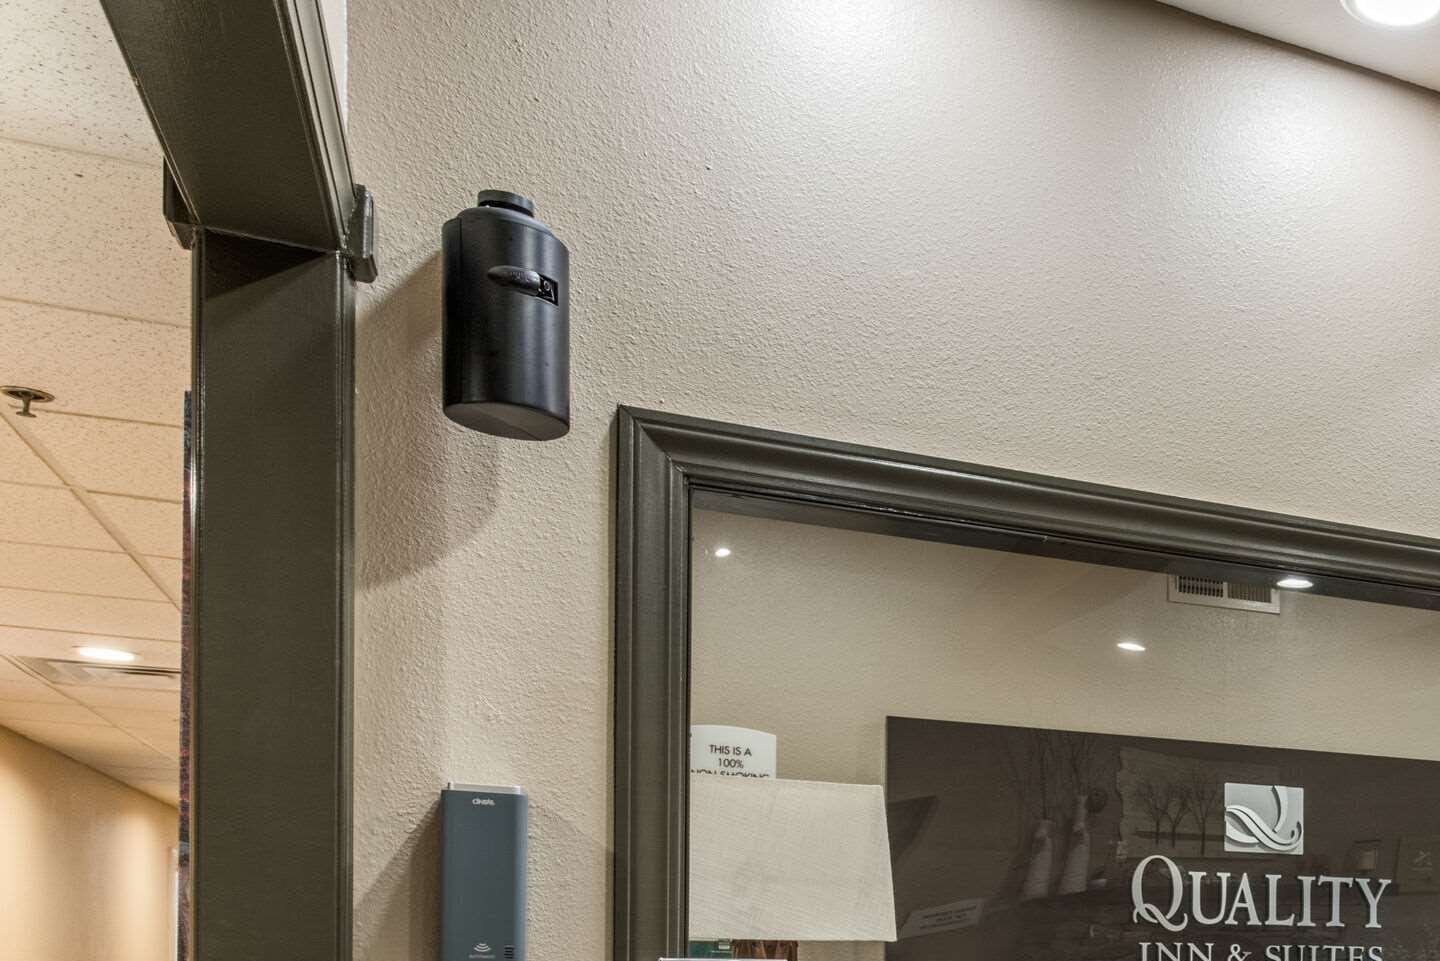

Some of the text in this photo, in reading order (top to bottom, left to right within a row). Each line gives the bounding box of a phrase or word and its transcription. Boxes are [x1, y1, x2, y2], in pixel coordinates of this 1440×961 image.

[709, 744, 752, 757] THIS IS A
[719, 758, 744, 769] 100%
